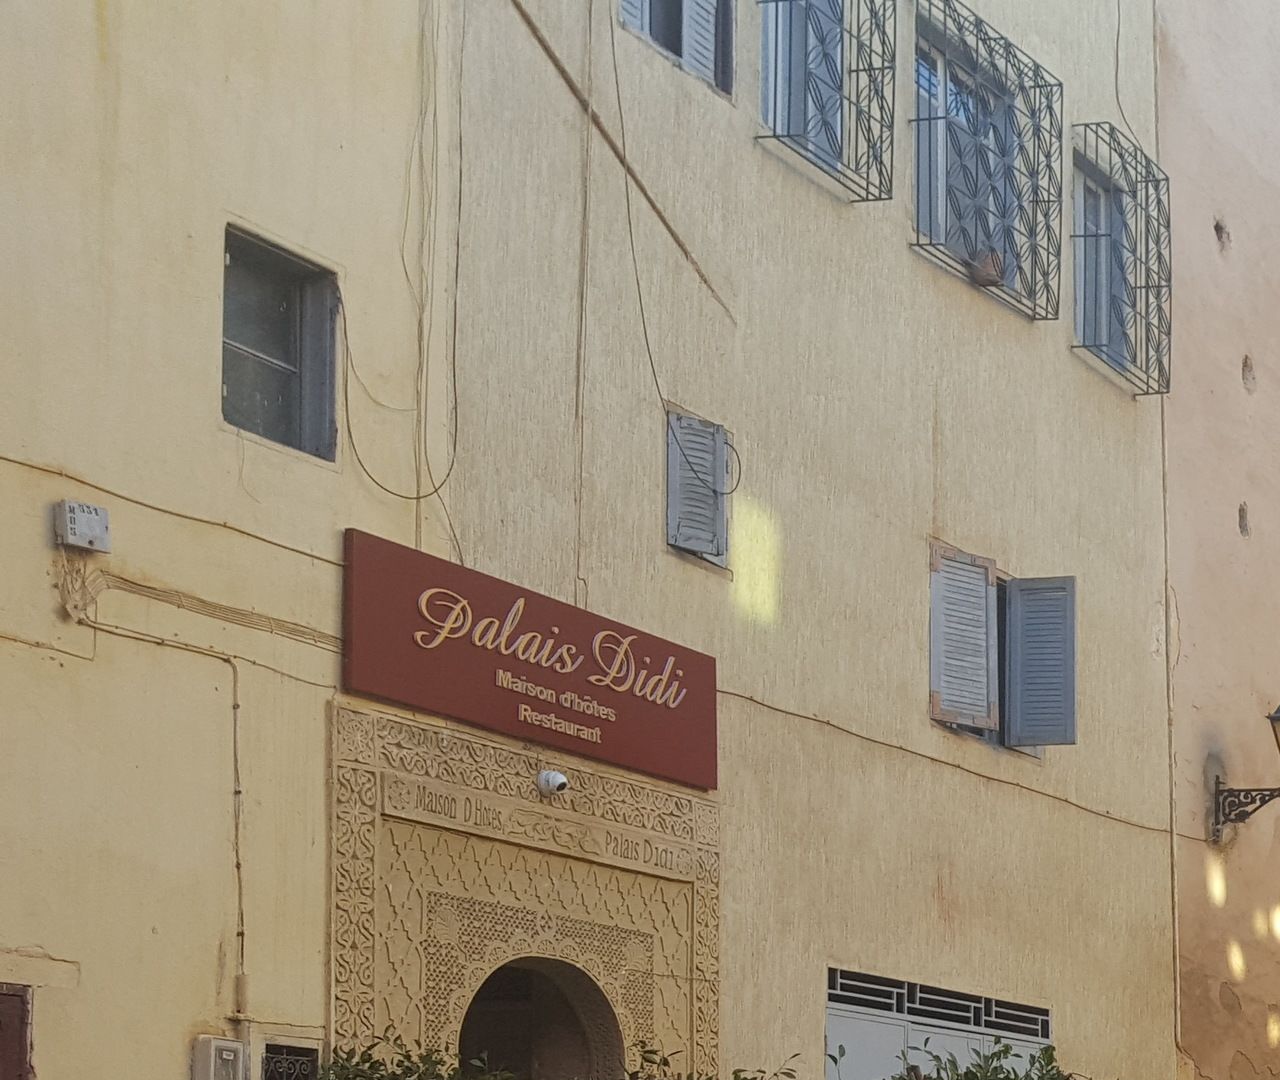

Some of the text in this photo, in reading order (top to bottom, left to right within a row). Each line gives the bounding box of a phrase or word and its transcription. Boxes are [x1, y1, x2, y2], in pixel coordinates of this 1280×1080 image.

[413, 587, 688, 709] Palais Didi
[496, 669, 616, 722] Maison d'hôtes
[518, 704, 602, 744] Restaurant
[415, 784, 457, 820] Maison
[605, 830, 640, 861] Palais
[643, 839, 673, 871] Didi
